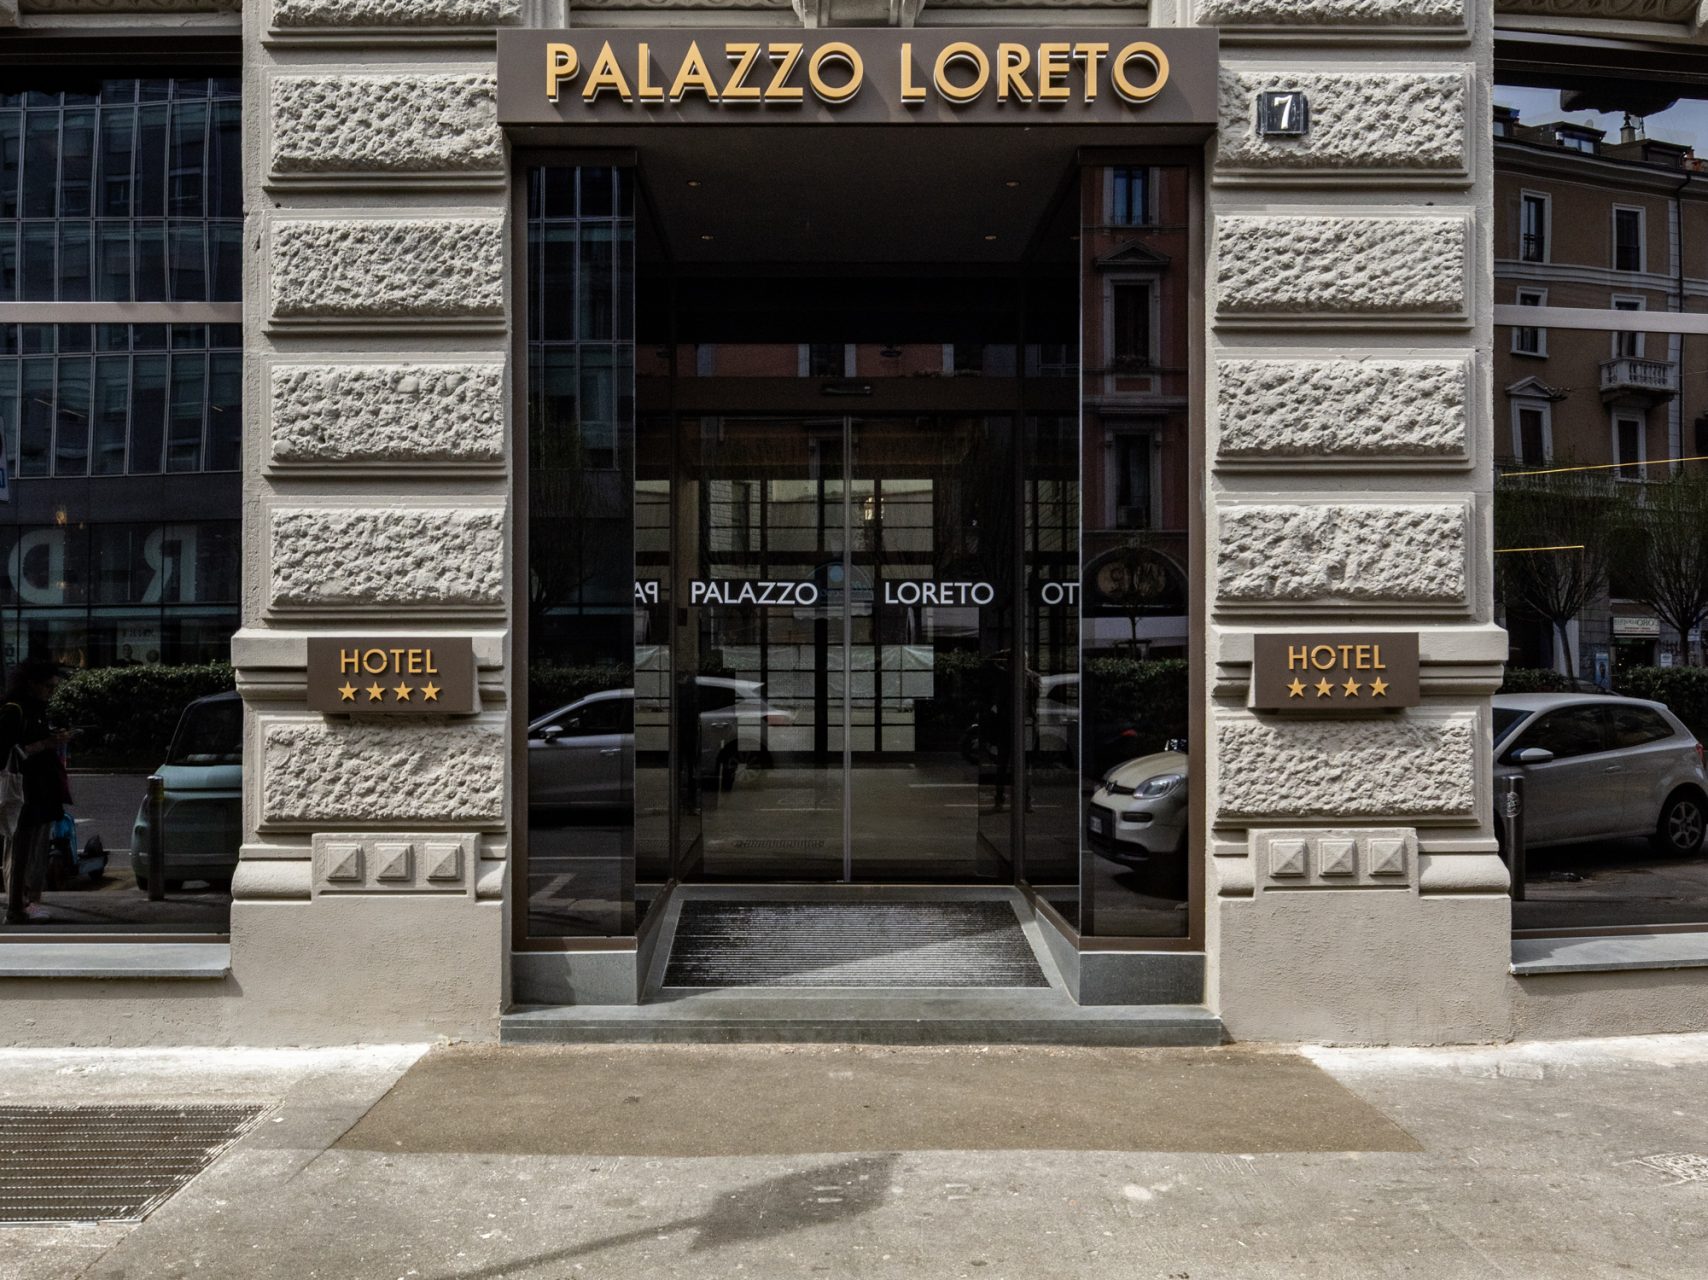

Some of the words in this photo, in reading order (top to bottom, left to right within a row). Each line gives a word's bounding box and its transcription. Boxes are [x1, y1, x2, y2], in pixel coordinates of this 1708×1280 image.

[546, 41, 864, 104] PALAZZO
[901, 41, 1169, 104] LORETO
[1274, 95, 1294, 129] 7
[691, 581, 818, 605] PALAZZO
[884, 581, 994, 605] LORETO
[341, 648, 438, 674] HOTEL
[1288, 644, 1386, 670] HOTEL
